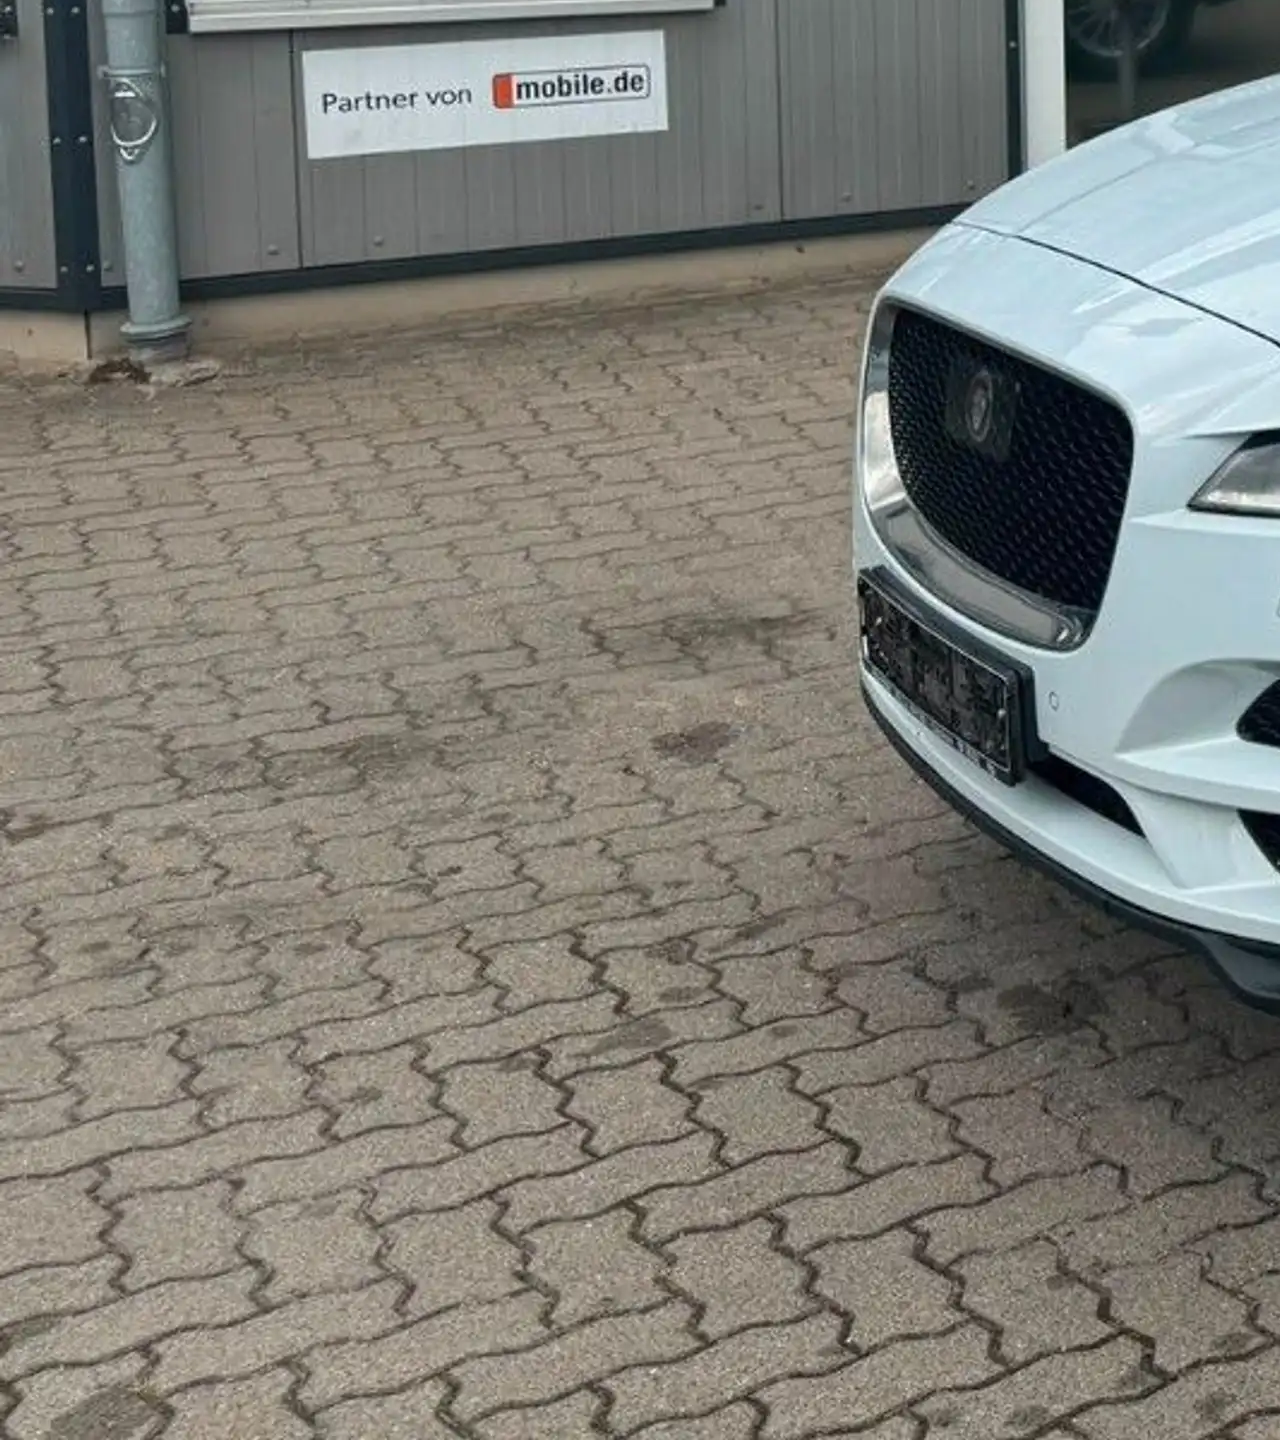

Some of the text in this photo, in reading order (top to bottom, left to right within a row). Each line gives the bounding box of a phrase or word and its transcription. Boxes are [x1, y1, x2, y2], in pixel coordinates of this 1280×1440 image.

[321, 67, 645, 115] Partner von mobile.de
